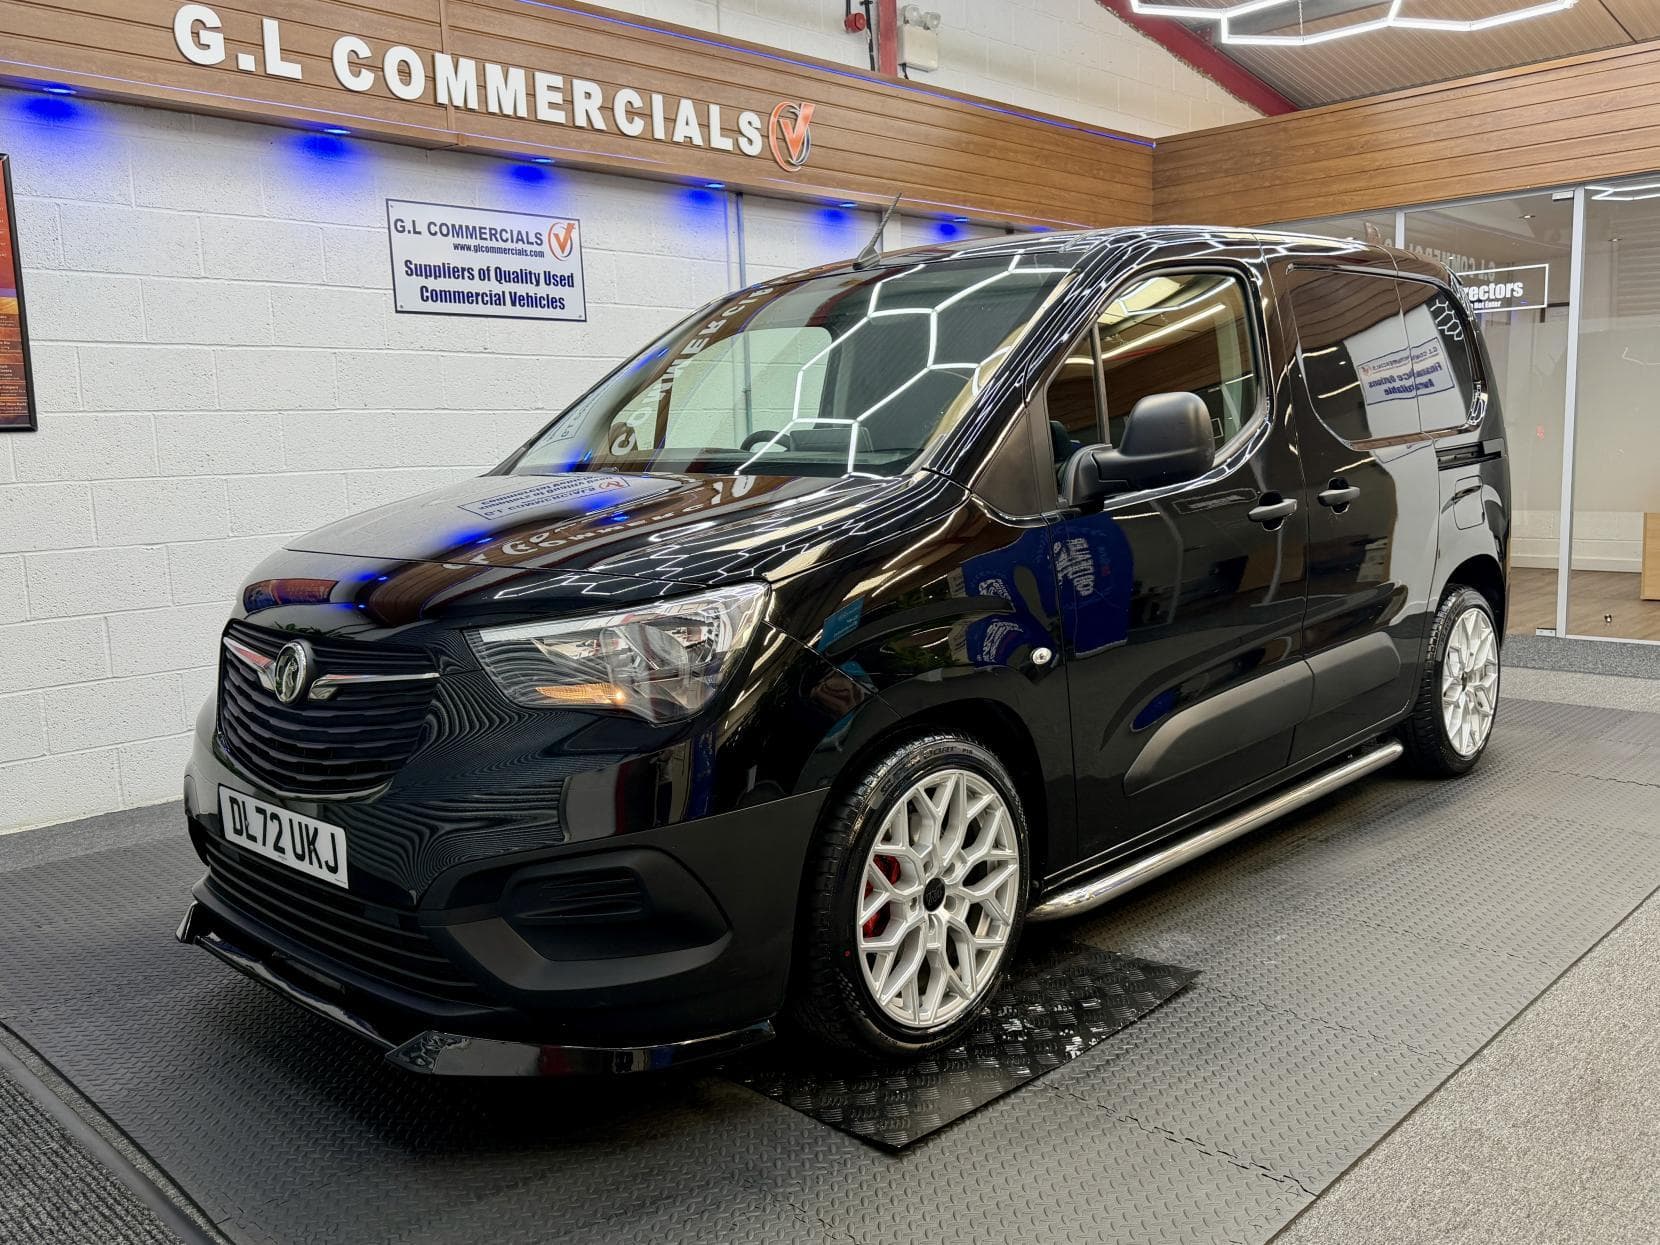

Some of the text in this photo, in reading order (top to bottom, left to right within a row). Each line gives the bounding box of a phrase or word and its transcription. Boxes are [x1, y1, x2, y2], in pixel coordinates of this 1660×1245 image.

[173, 4, 763, 156] G.L COMMERCIALS
[394, 218, 544, 246] G.L COMMERCIALS
[453, 242, 545, 258] www.glcommercials.com
[404, 259, 575, 288] Suppliers of Quality Used
[420, 285, 566, 310] Commercial Vehicles
[1463, 281, 1524, 301] rectors
[229, 796, 339, 875] DL72 UKJ
